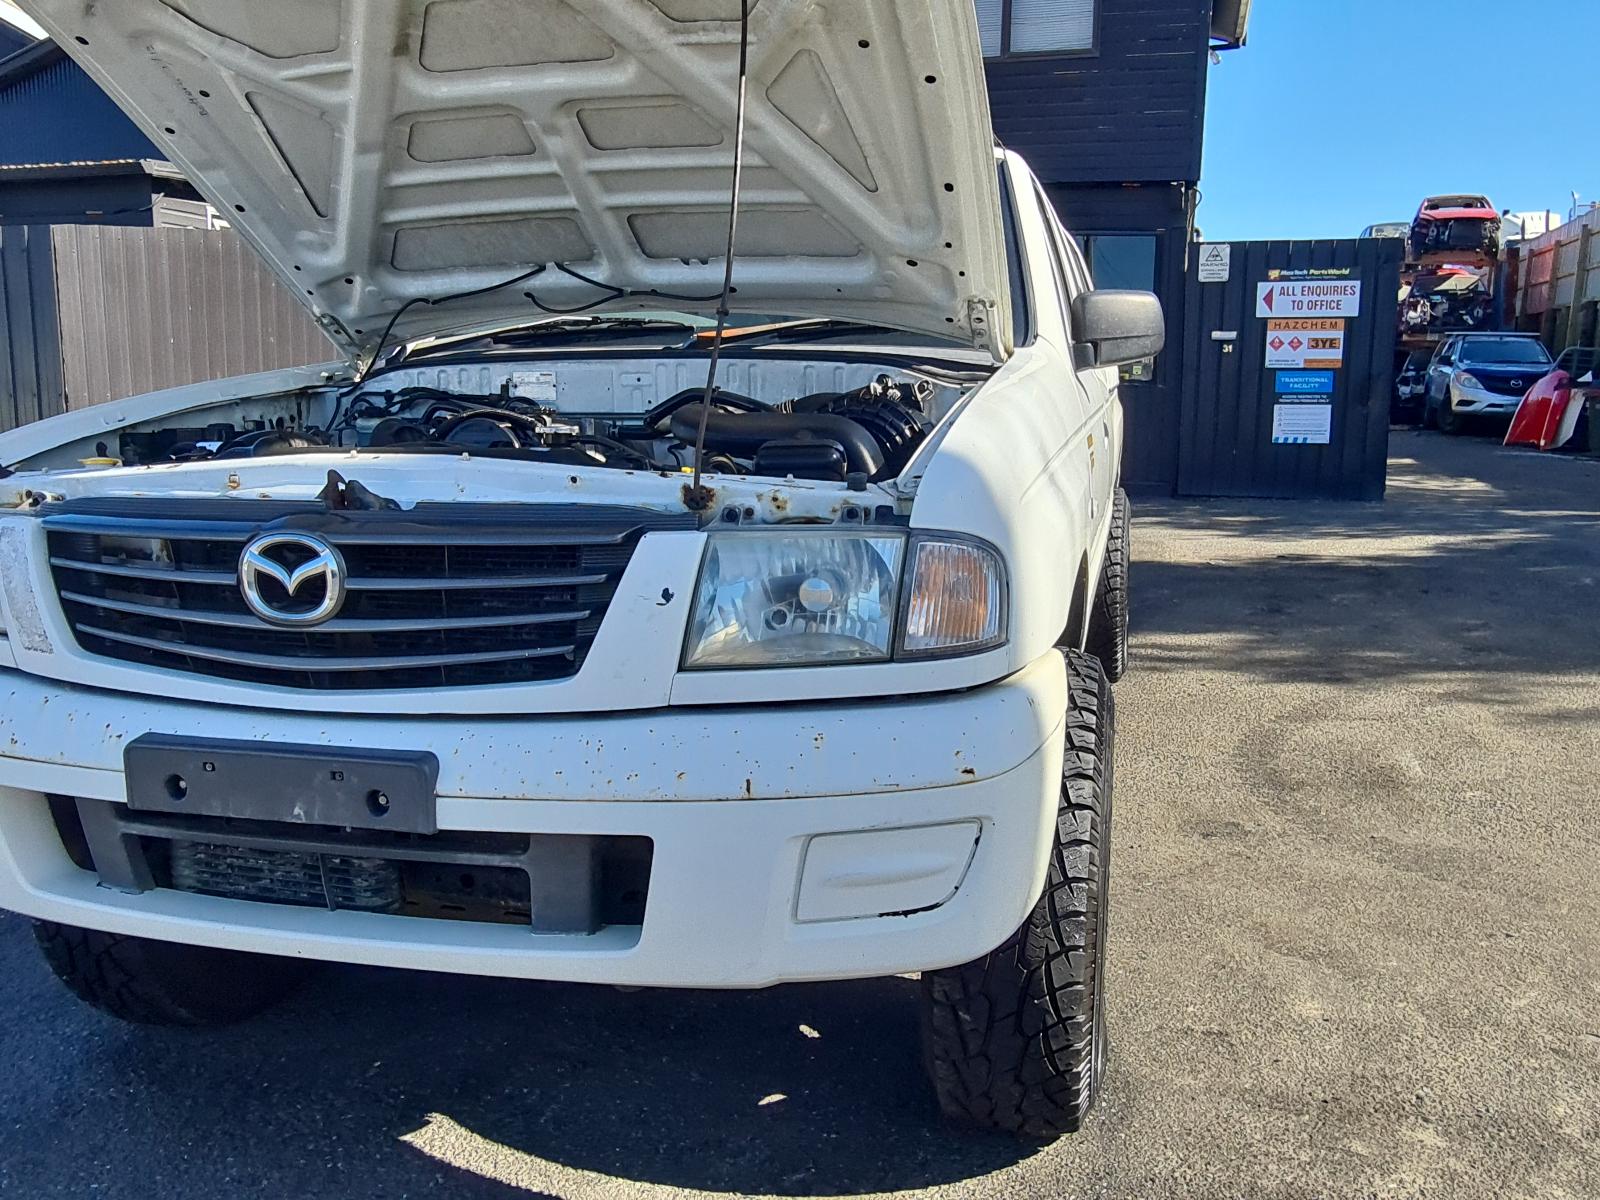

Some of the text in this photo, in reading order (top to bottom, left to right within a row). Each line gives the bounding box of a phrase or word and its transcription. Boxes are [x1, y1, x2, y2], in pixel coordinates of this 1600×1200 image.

[1279, 285, 1356, 297] ALL ENQUIRIES
[1291, 300, 1342, 310] TO OFFICE
[1273, 321, 1338, 330] HAZCHEM
[1311, 339, 1337, 348] 3YE
